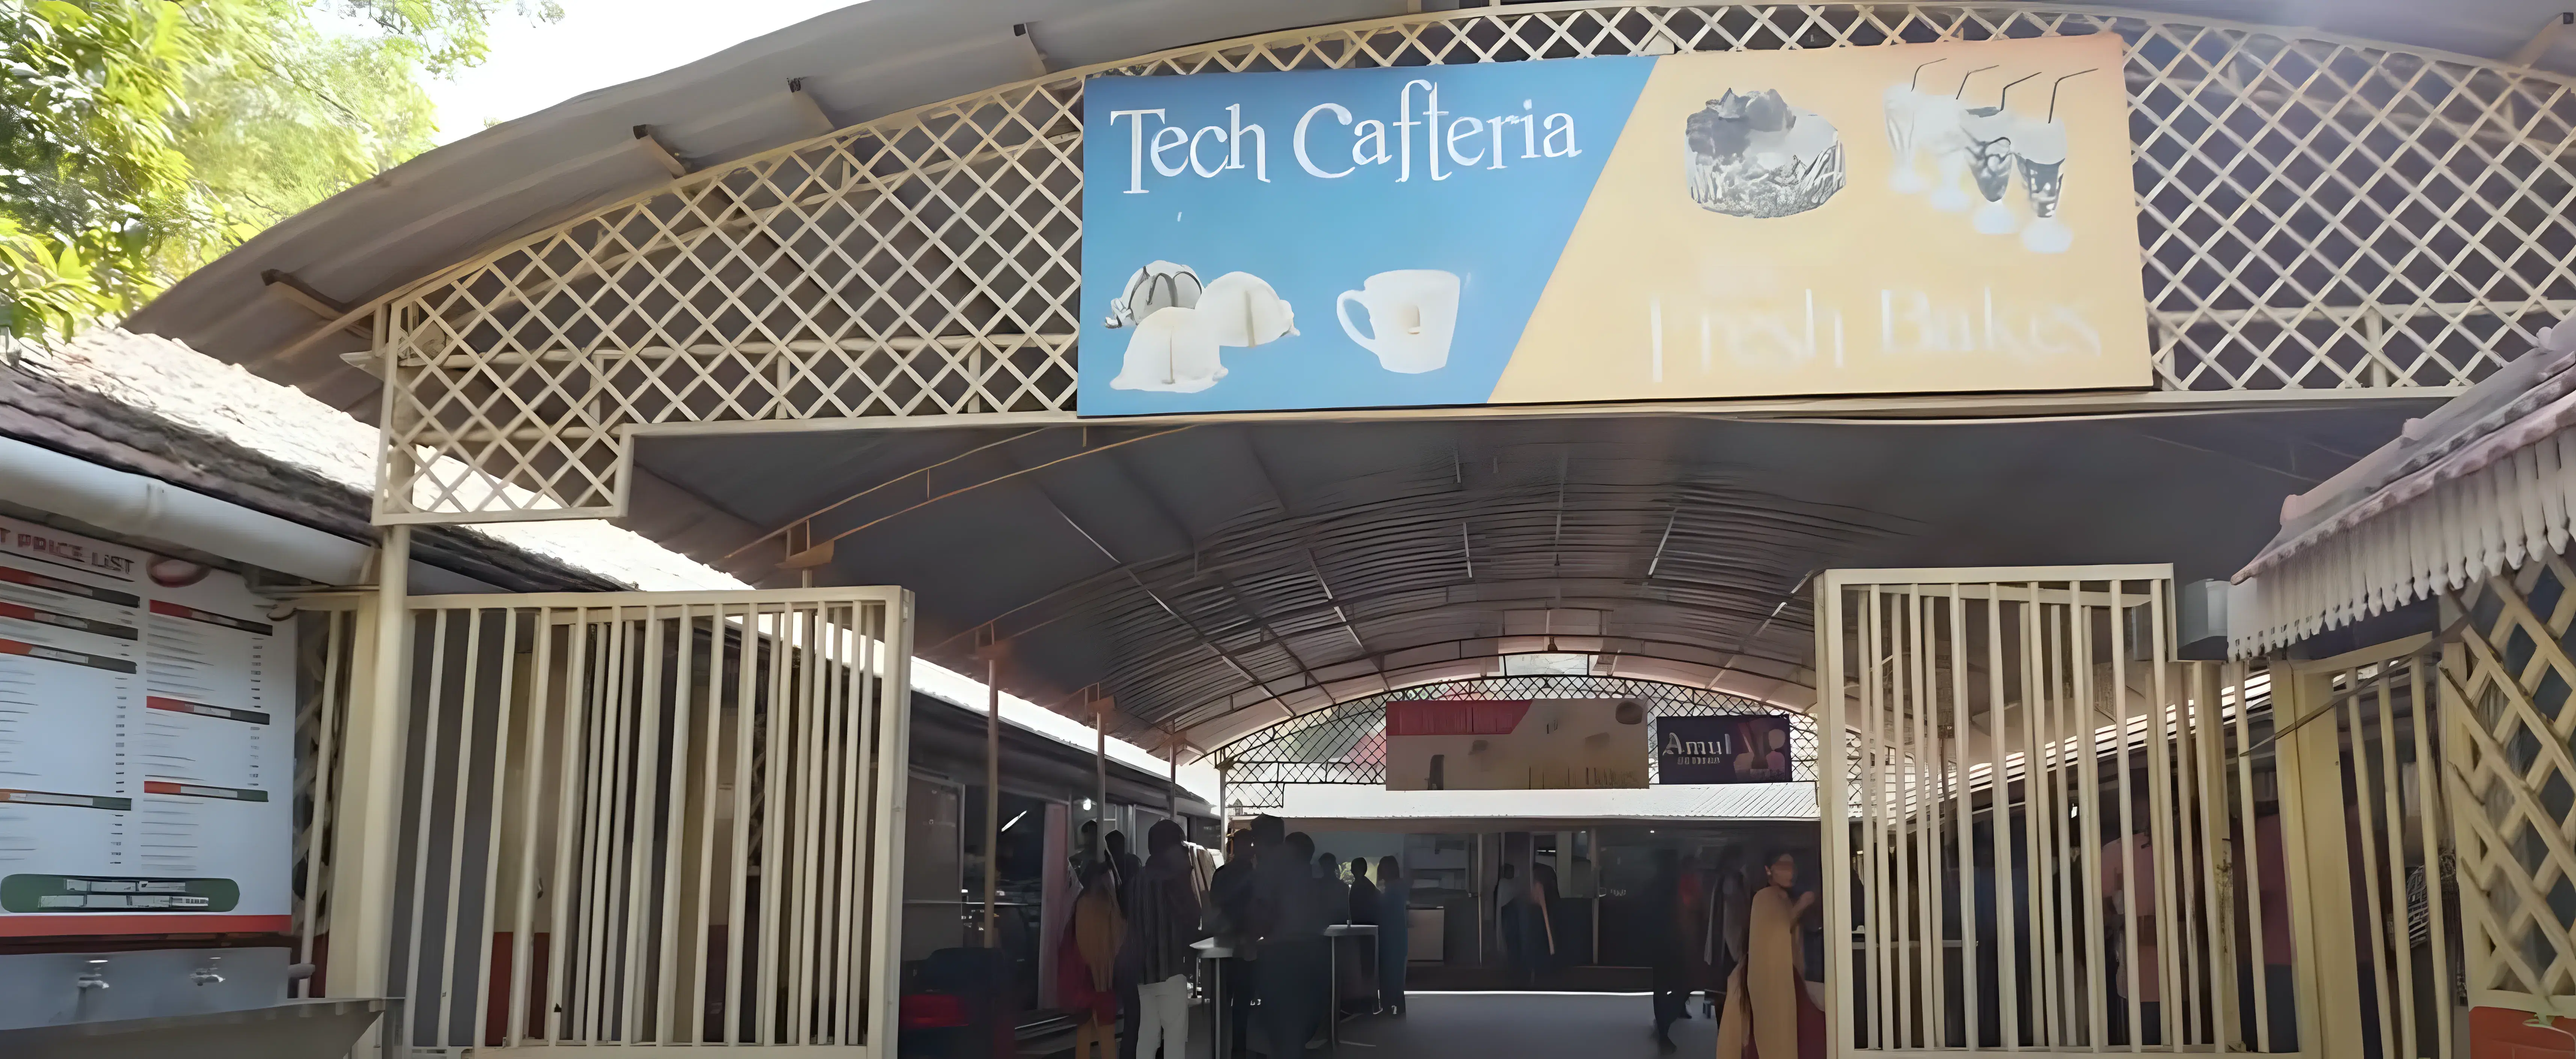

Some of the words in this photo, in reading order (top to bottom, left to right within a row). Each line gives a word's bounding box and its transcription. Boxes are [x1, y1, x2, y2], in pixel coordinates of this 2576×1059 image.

[1110, 103, 1271, 194] Tech
[1293, 79, 1582, 183] Cafteria
[92, 552, 134, 575] LIST
[1662, 732, 1732, 756] Amul
